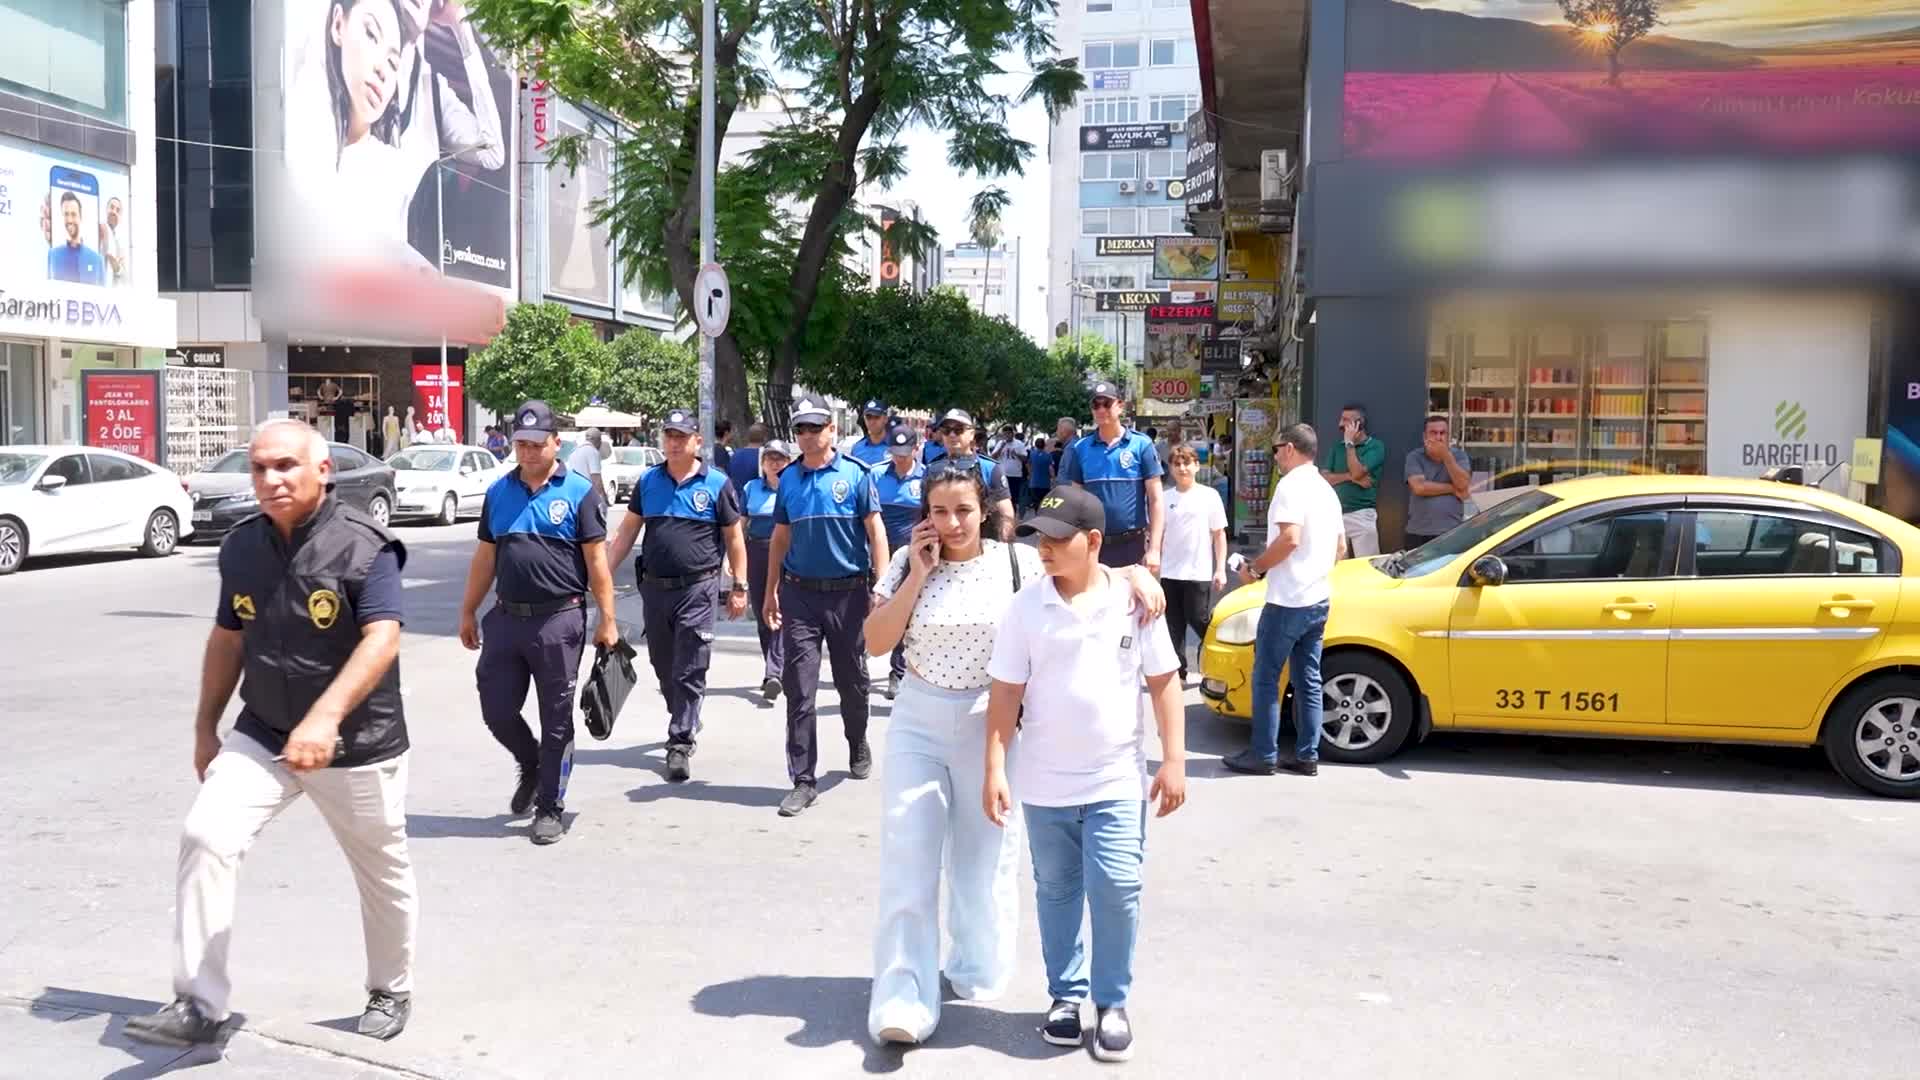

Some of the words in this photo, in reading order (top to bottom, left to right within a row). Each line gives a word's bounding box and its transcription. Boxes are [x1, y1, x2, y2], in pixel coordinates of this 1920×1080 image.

[531, 98, 549, 150] yeni
[1112, 131, 1160, 139] AVUKAT
[1185, 165, 1216, 192] EROTİK
[1107, 239, 1154, 249] MERCAN
[1119, 293, 1160, 304] AKCAN
[66, 299, 122, 323] BBVA
[193, 353, 221, 363] COLIN'S
[1151, 380, 1189, 396] 300
[106, 409, 114, 421] 3
[117, 409, 135, 421] AL
[100, 427, 108, 439] 2
[112, 424, 142, 439] ÖDE
[1041, 497, 1064, 508] EA7
[1495, 689, 1525, 709] 33
[1534, 690, 1551, 710] T
[1560, 691, 1619, 712] 1561
